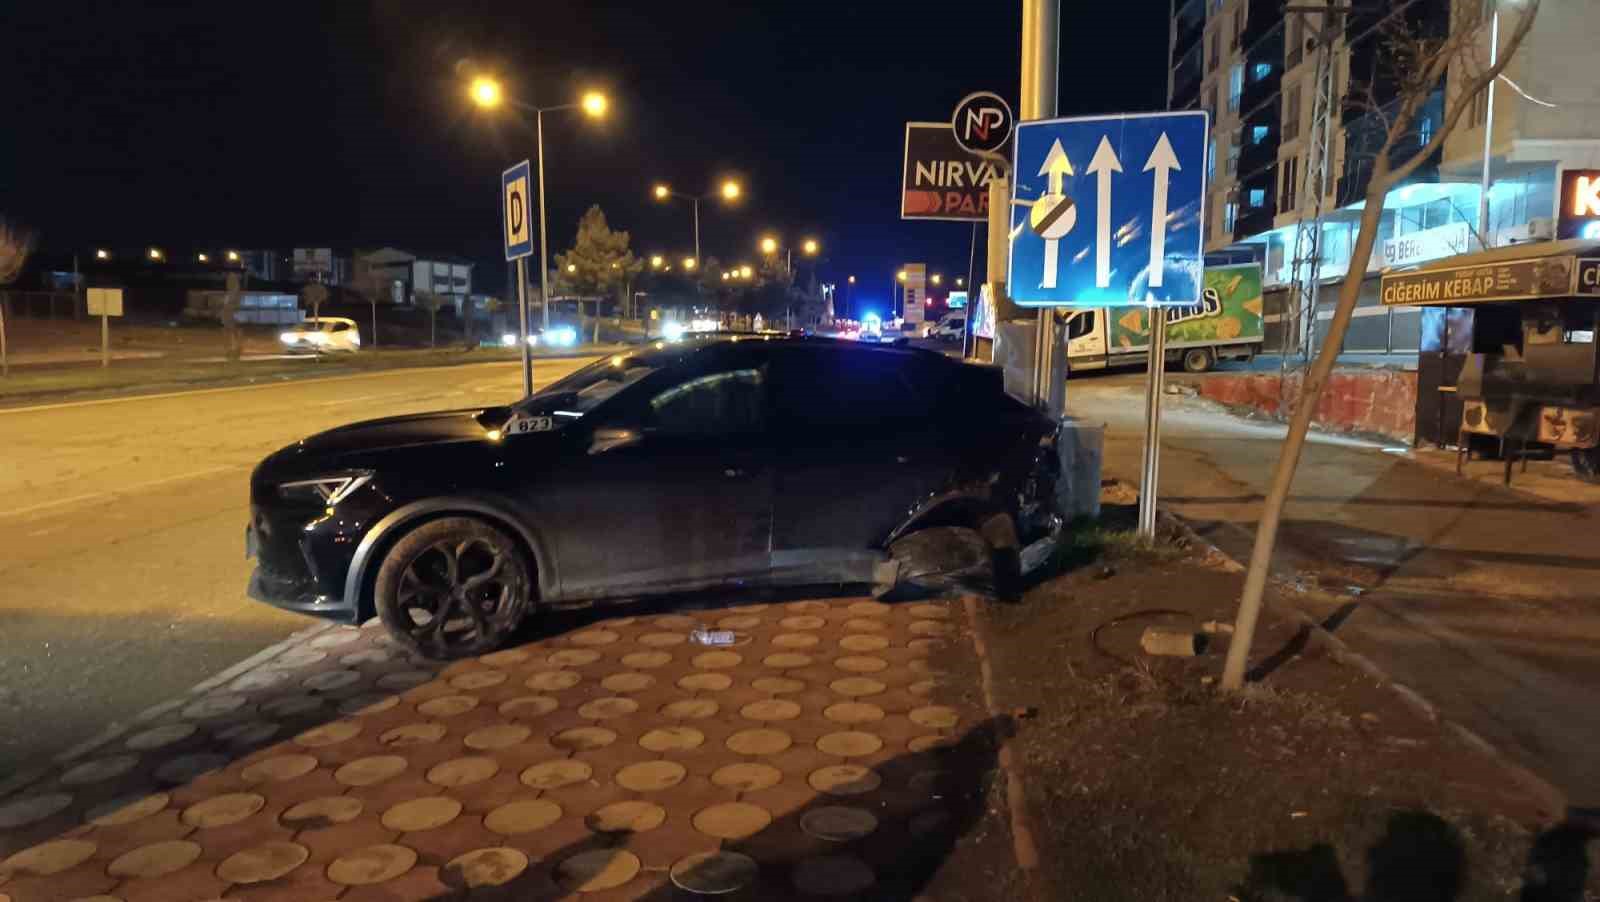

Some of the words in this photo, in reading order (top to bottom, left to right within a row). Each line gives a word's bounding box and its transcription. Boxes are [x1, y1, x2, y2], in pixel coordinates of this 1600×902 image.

[915, 159, 998, 188] NIRVA
[510, 190, 523, 235] D
[945, 190, 990, 214] PAR
[1444, 276, 1494, 298] KEBAP
